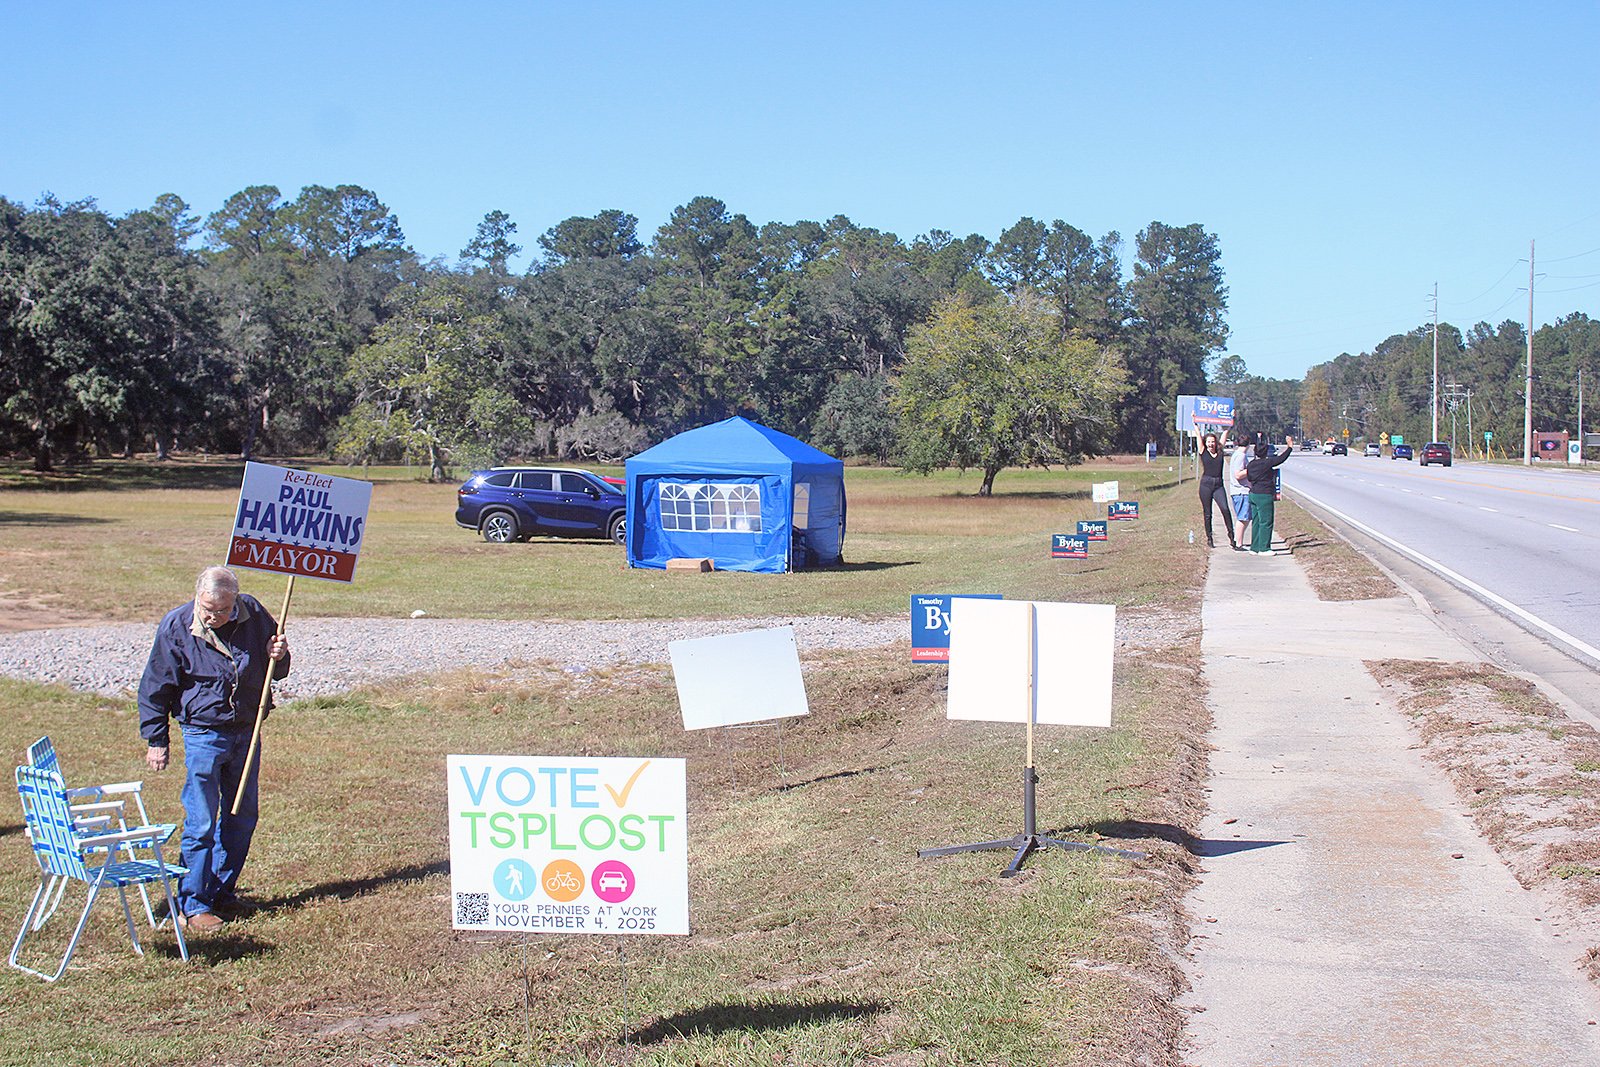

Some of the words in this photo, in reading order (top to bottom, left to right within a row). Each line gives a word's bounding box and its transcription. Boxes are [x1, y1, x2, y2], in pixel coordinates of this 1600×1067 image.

[1199, 400, 1230, 413] Byler
[284, 470, 334, 489] Re-Elect
[278, 484, 332, 510] PAUL
[237, 498, 363, 546] HAWKINS
[1082, 523, 1104, 533] Byler
[1059, 538, 1084, 549] Byler
[245, 543, 338, 575] MAYOR
[917, 597, 943, 606] Timothy
[459, 766, 600, 808] VOTE
[460, 811, 675, 852] TSPLOST
[493, 903, 529, 914] YOUR
[537, 904, 590, 915] PENNIES
[597, 905, 613, 916] AT
[620, 906, 657, 917] WORK
[495, 914, 585, 929] NOVEMBER
[617, 917, 656, 930] 2025
